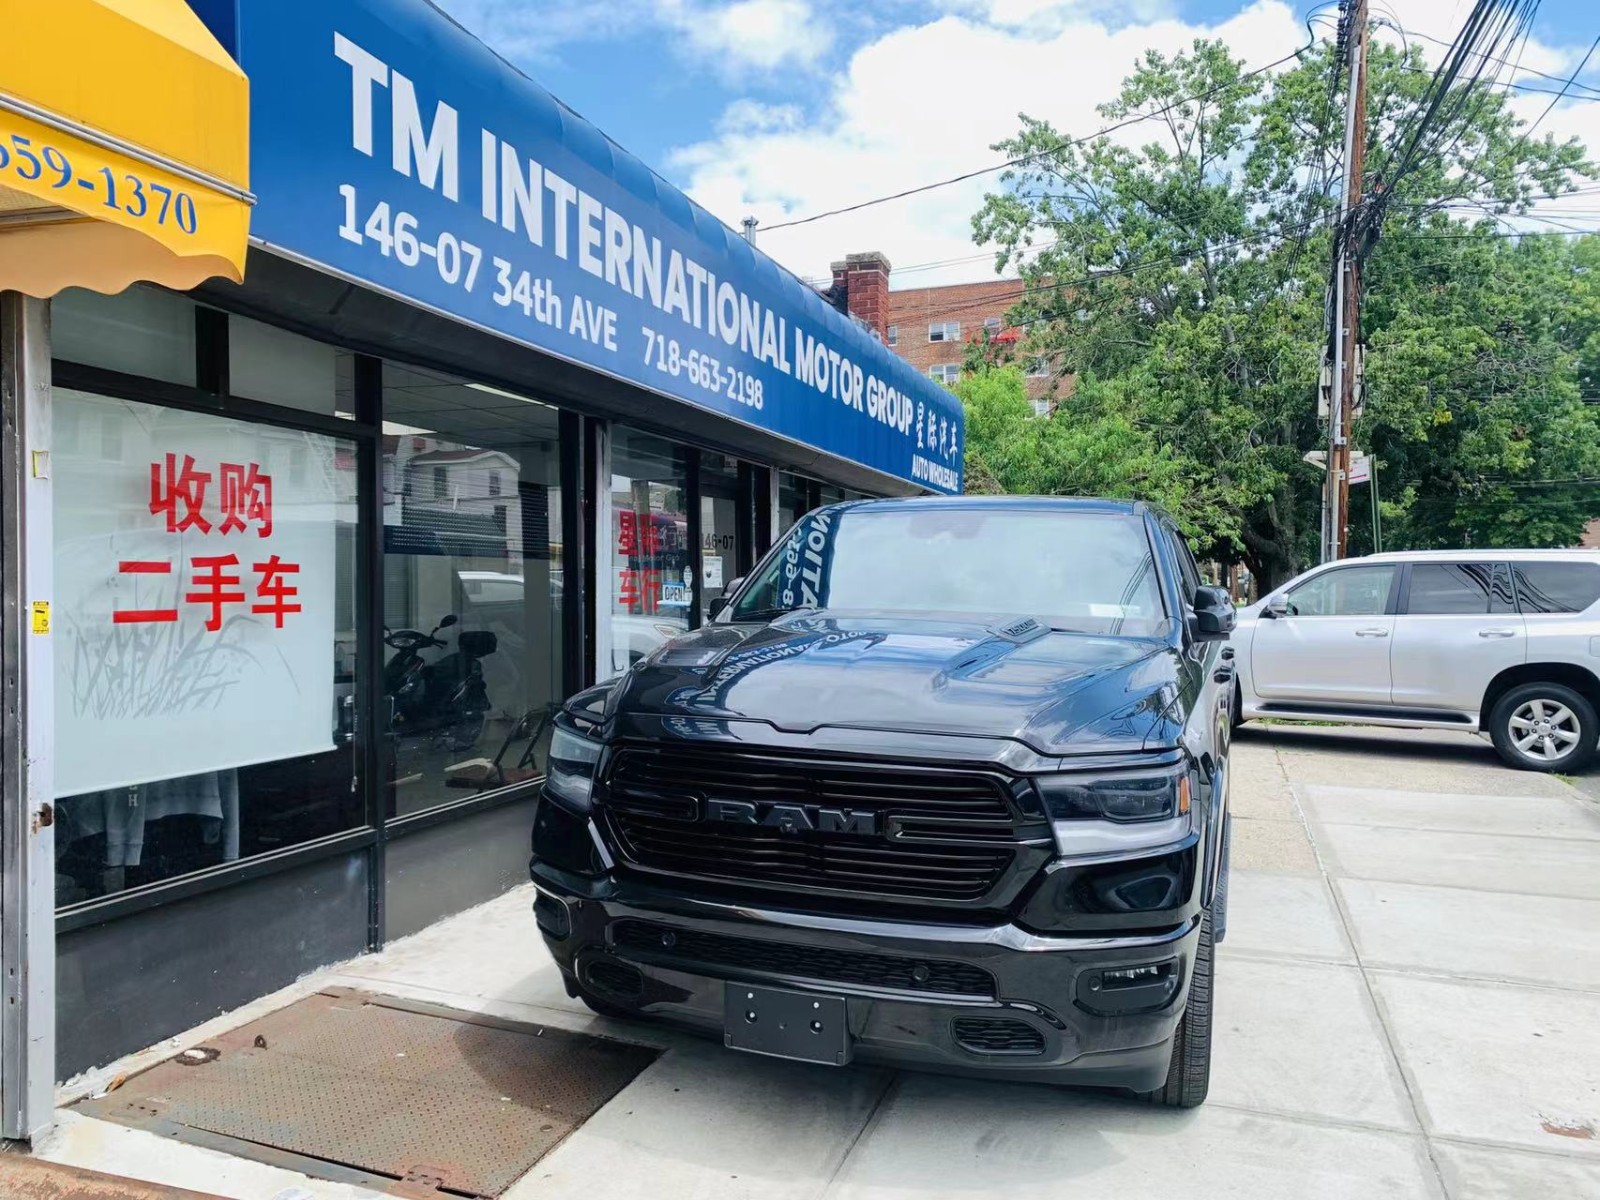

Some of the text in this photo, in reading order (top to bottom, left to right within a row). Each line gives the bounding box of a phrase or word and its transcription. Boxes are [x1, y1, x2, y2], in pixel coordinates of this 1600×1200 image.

[333, 31, 913, 436] TM INTERNATIONAL MOTOR GROUP
[338, 184, 618, 353] 146-07 34th AVE
[642, 326, 764, 411] 718-663-2198
[149, 453, 272, 538] 收购
[911, 454, 958, 492] AUTO WHOLESALE
[113, 553, 302, 632] 二手车
[664, 586, 684, 602] OPEN
[706, 799, 876, 837] RAM
